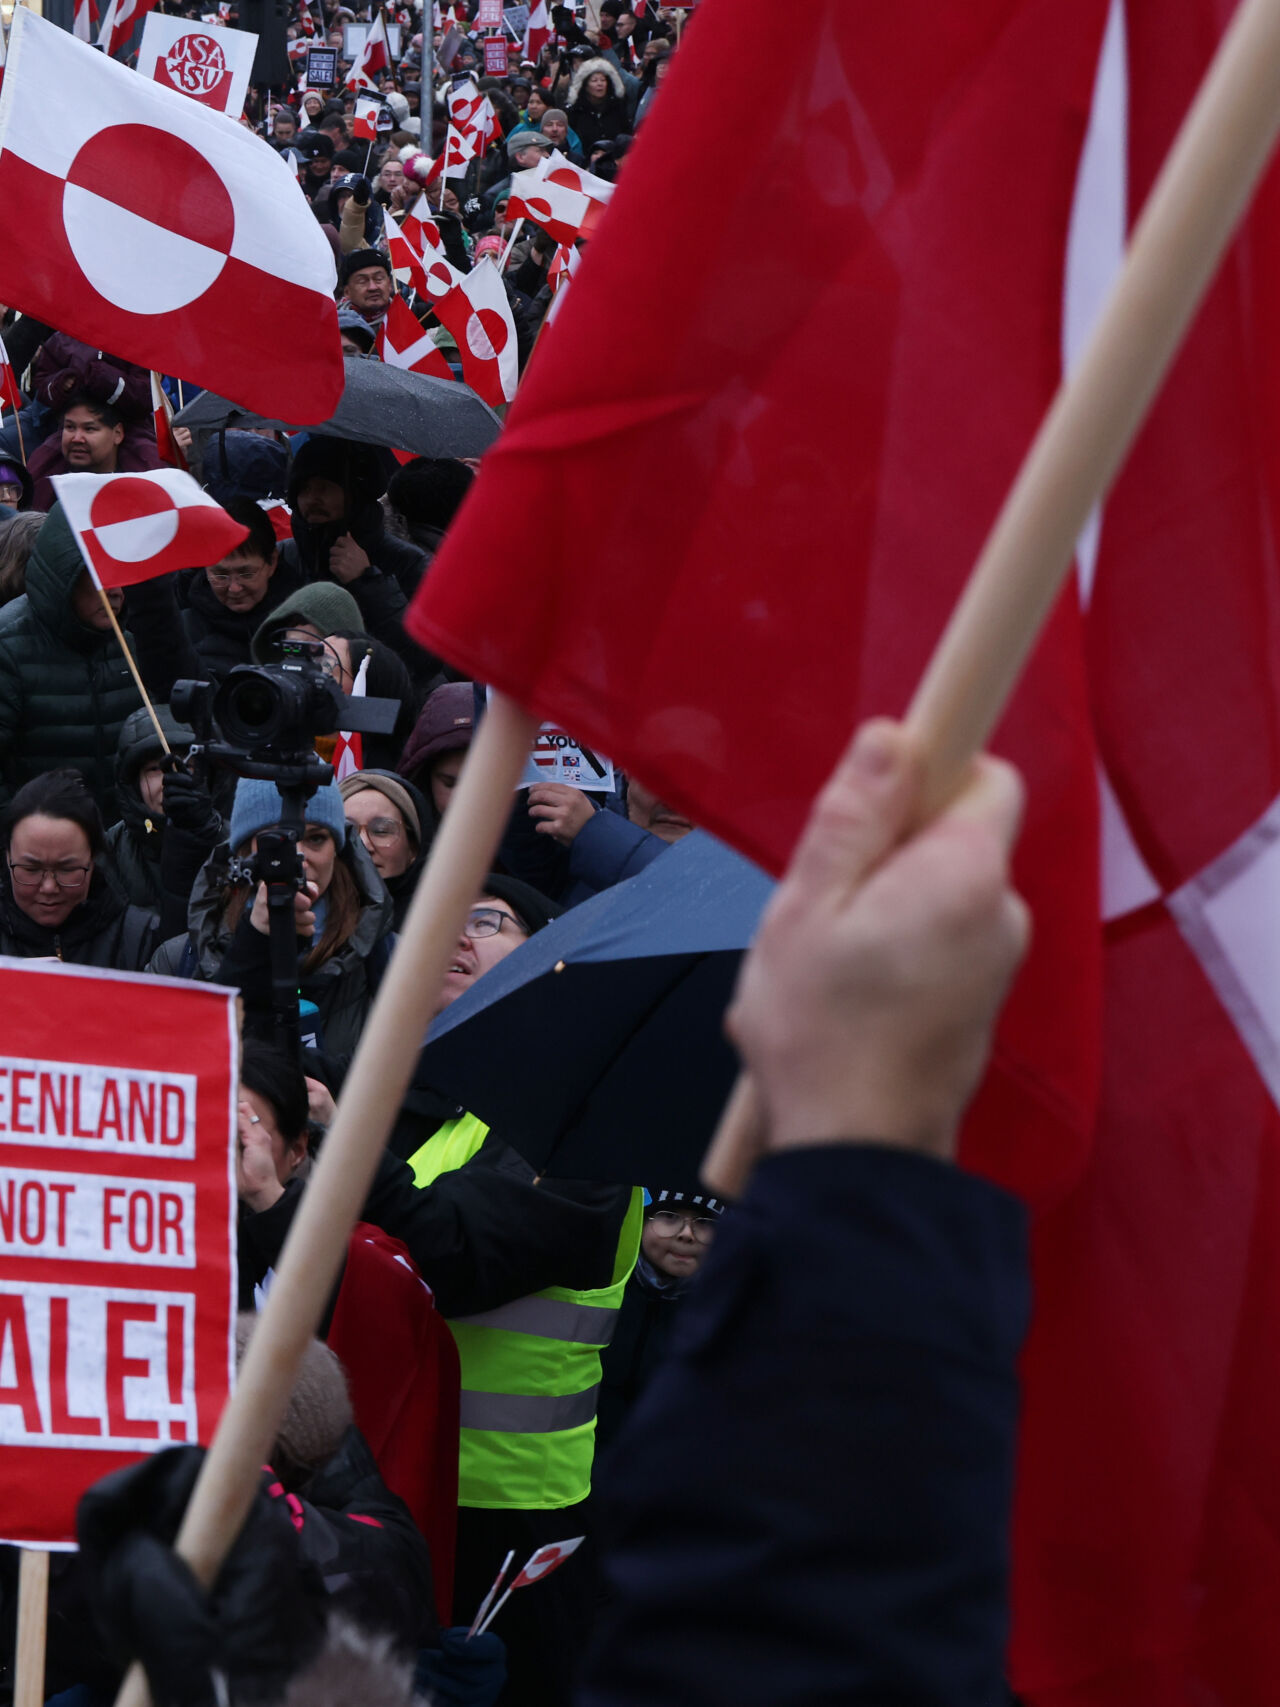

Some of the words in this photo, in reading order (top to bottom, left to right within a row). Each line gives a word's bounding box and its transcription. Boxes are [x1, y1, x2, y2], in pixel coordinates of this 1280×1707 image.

[175, 36, 223, 70] USA
[310, 70, 332, 83] SALE!
[102, 1187, 185, 1257] FOR
